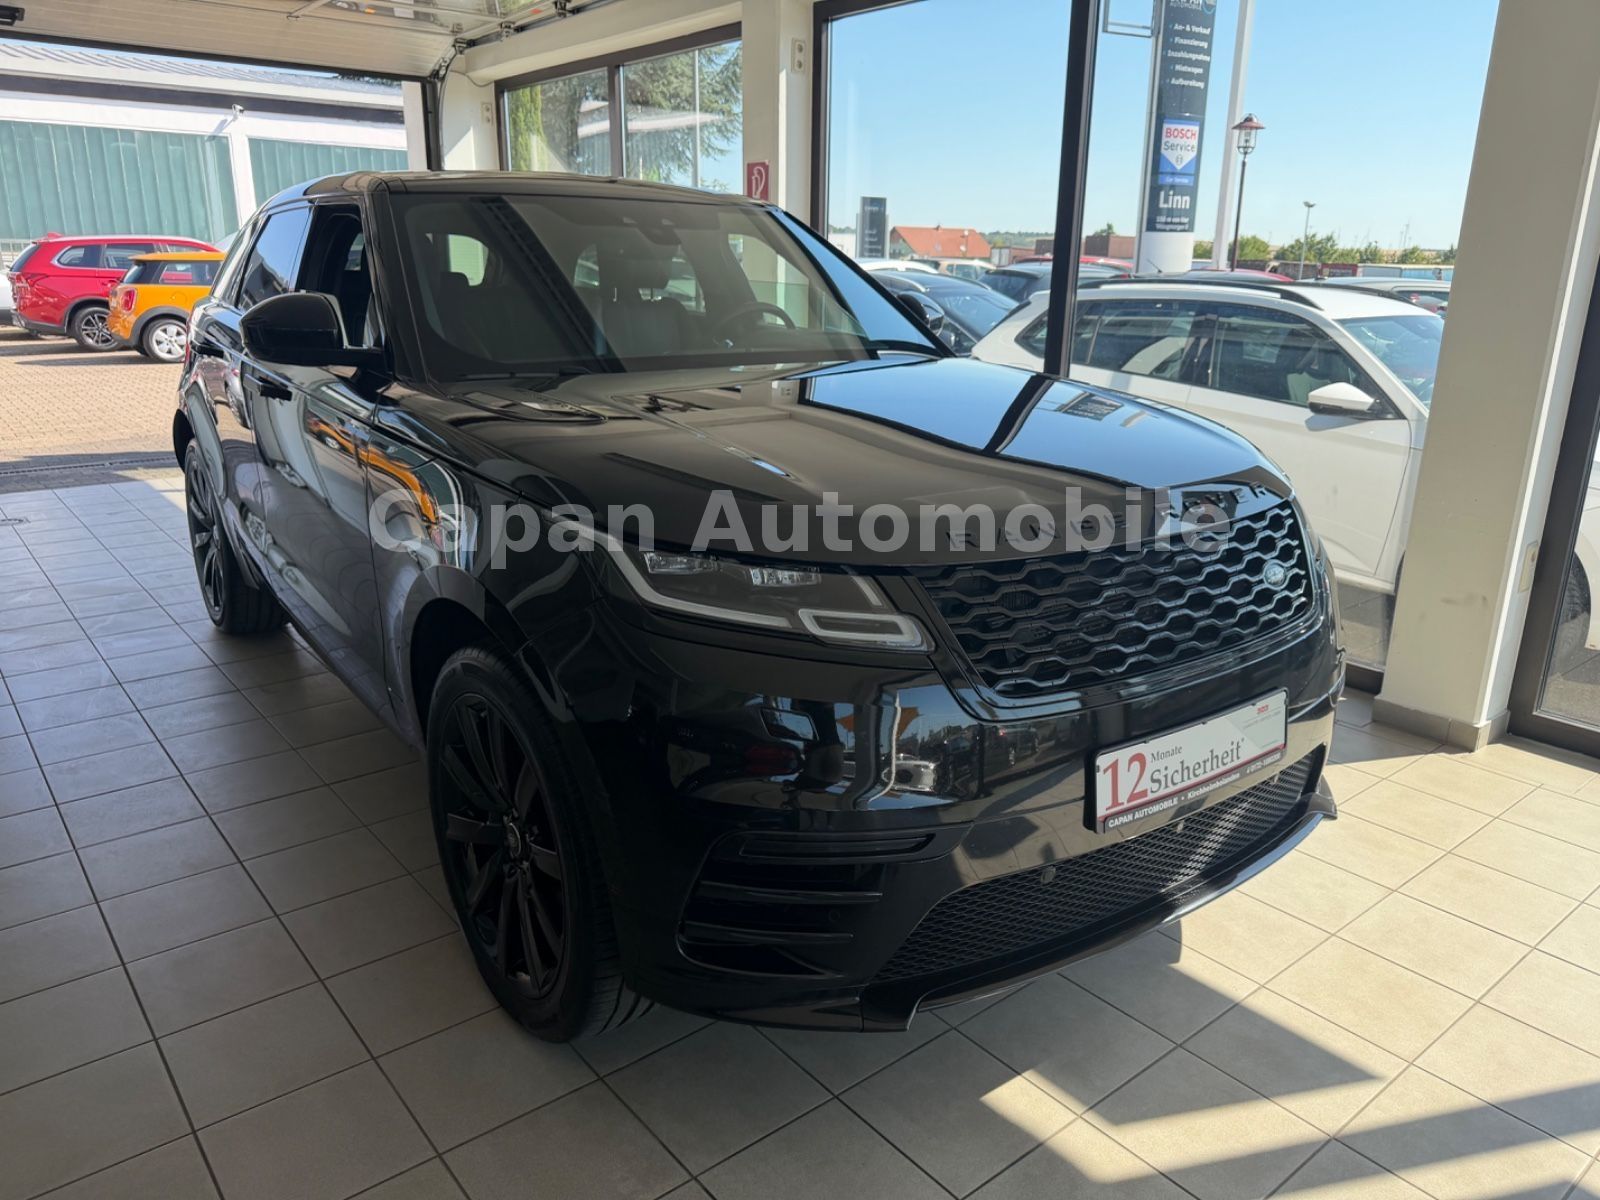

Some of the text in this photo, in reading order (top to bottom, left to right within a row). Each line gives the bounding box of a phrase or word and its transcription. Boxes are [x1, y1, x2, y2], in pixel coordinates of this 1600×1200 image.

[1174, 36, 1208, 49] Finanzierung
[1165, 127, 1197, 140] BOSCH
[1163, 141, 1196, 152] Service
[1159, 190, 1191, 209] Linn
[1151, 745, 1183, 764] Monate
[1103, 739, 1242, 812] 12 Sicherheit
[1108, 813, 1134, 829] CAPAN
[1134, 797, 1179, 820] AUTOMOBILE
